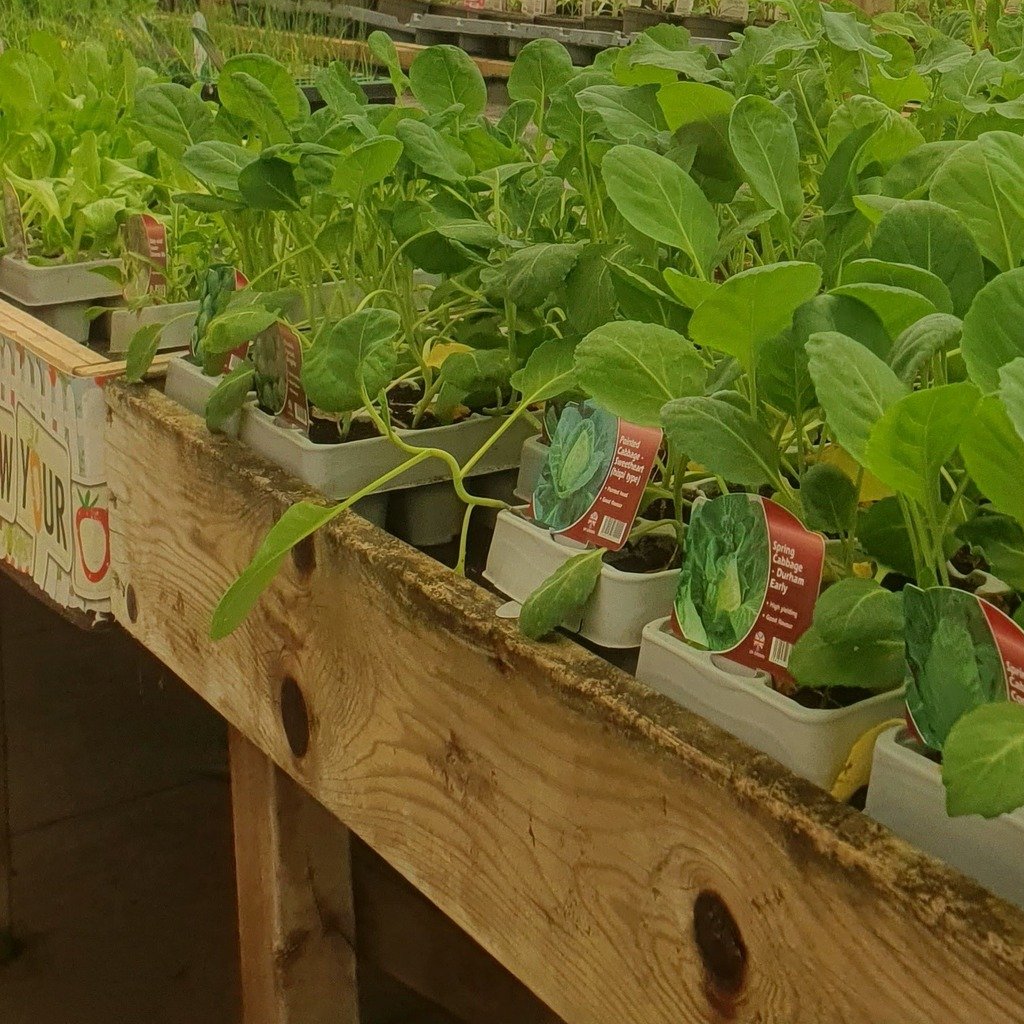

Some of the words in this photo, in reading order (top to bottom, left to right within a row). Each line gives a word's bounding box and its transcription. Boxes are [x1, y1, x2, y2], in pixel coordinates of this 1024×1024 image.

[617, 446, 641, 462] Cabbage
[613, 456, 645, 474] Sweetheart
[772, 540, 795, 560] Spring
[772, 554, 804, 574] Cabbage
[776, 567, 805, 587] Durham
[769, 578, 789, 596] Early
